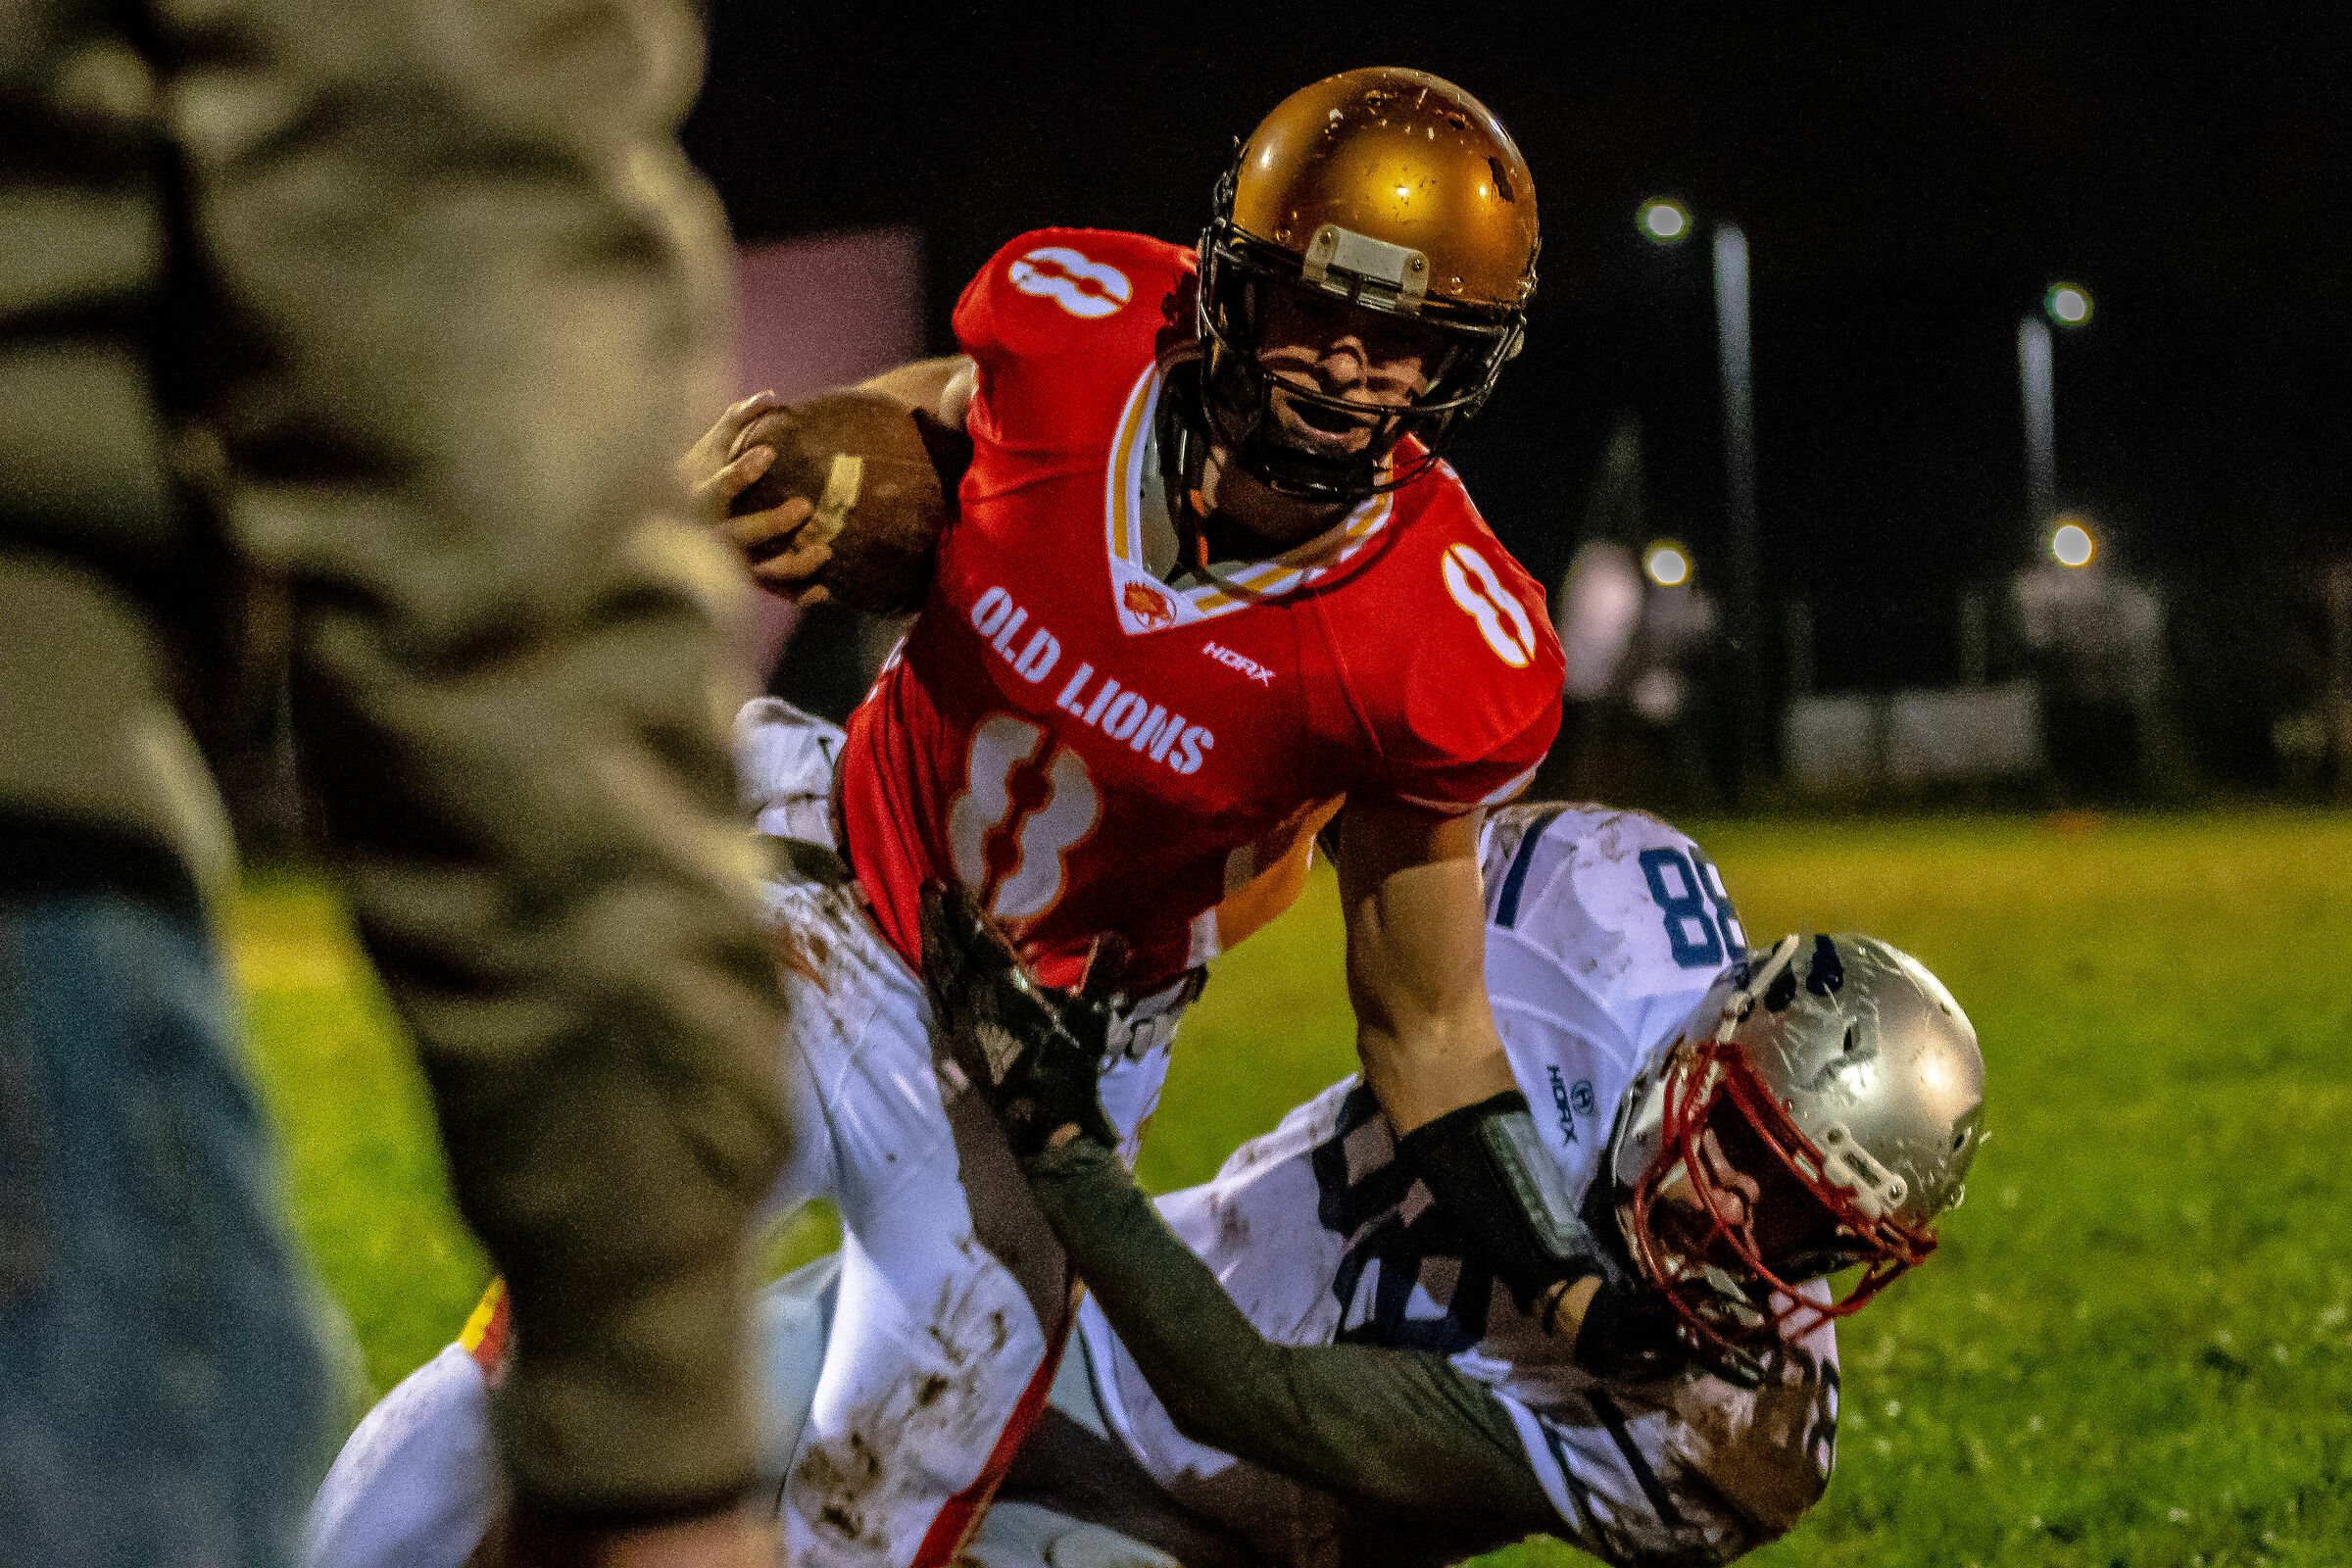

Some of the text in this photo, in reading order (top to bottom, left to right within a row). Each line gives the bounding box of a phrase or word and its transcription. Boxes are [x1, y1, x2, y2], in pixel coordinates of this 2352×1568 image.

[1007, 247, 1131, 318] 8
[1442, 543, 1537, 668] 8
[971, 586, 1214, 774] OLD LIONS
[949, 712, 1103, 923] 8
[1639, 846, 1747, 968] 88
